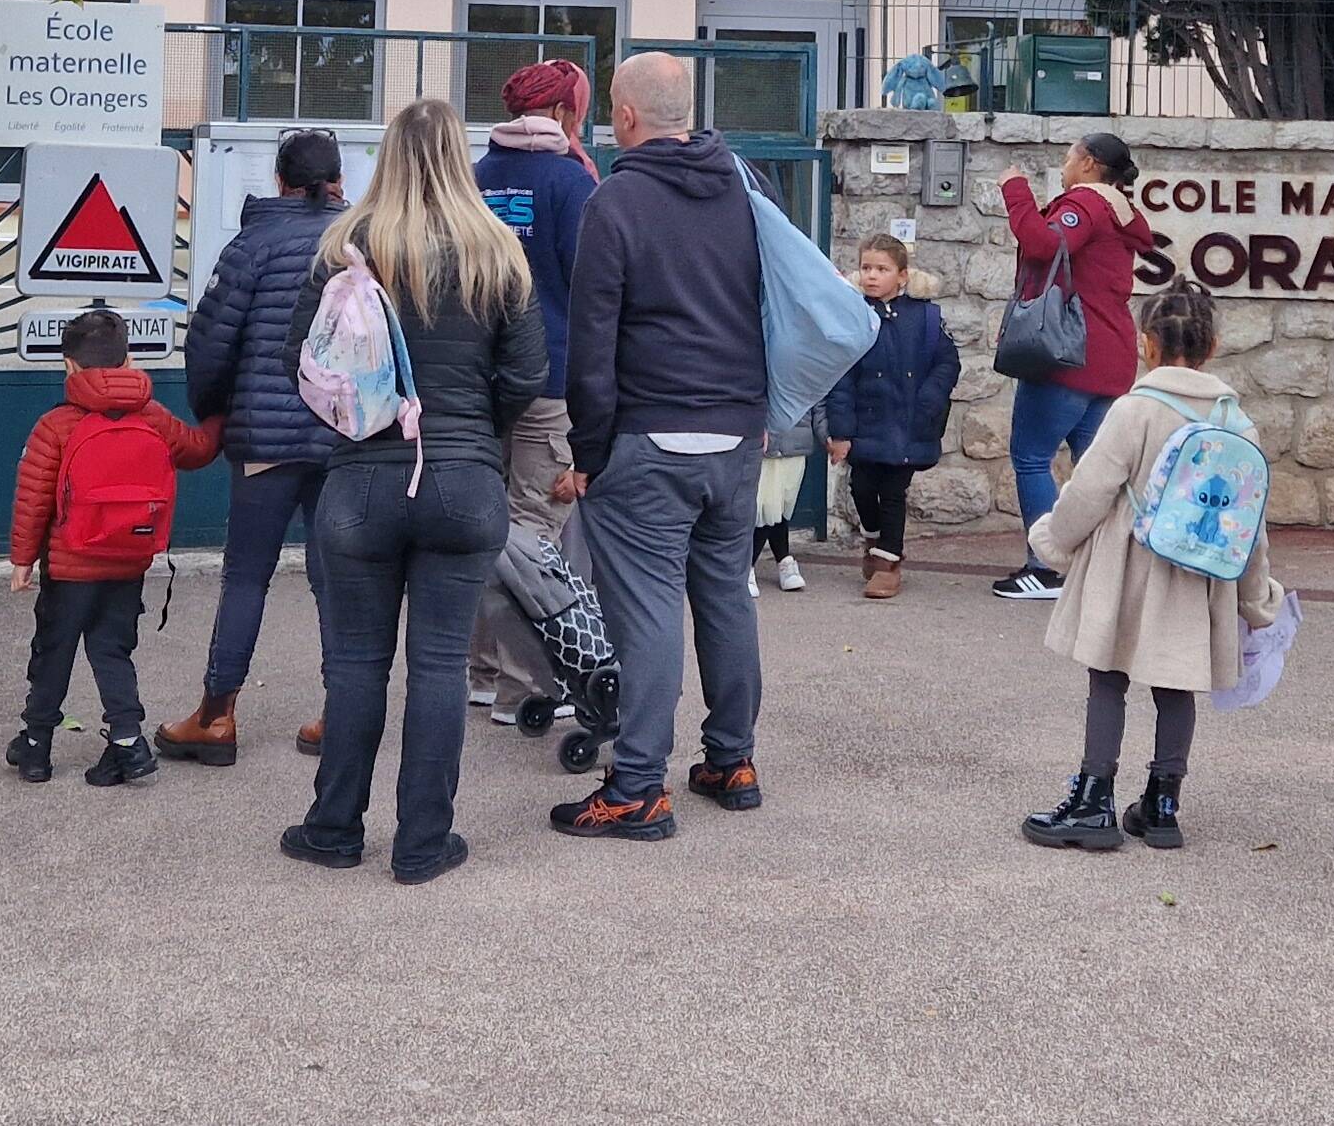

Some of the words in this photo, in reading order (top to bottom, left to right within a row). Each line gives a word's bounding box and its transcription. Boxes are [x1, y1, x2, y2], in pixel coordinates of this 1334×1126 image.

[46, 11, 114, 42] École
[9, 52, 147, 75] maternelle
[6, 85, 43, 106] Les
[49, 86, 148, 113] Orangers
[7, 121, 39, 131] Liberté
[101, 122, 145, 133] Fraternité
[55, 254, 137, 270] VIGIPIRATE
